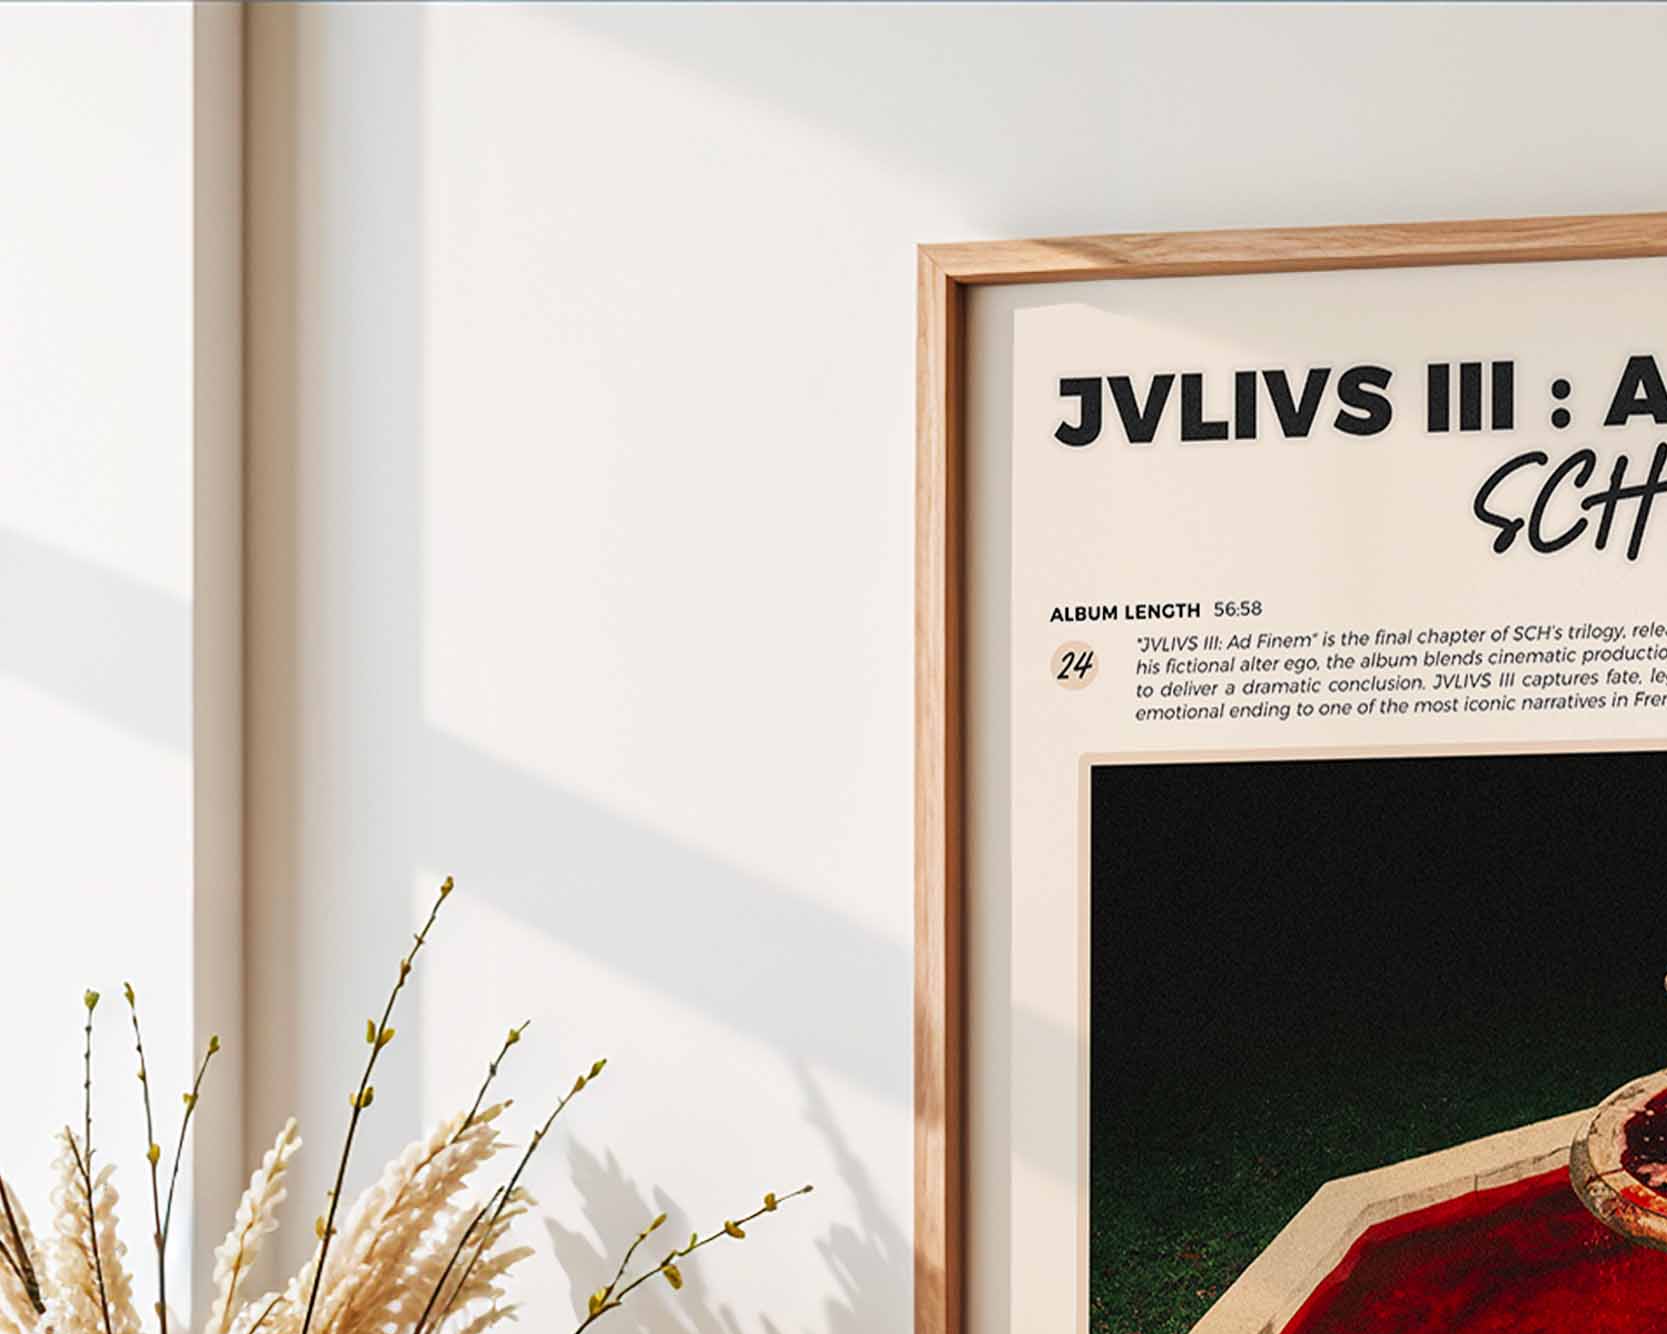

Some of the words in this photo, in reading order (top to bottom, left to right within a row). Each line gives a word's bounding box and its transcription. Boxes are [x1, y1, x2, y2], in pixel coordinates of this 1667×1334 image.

[1054, 365, 1393, 446] JVLIVS
[1426, 360, 1514, 433] III
[1550, 377, 1572, 429] :
[1049, 604, 1118, 623] ALBUM
[1124, 602, 1201, 621] LENGTH
[1213, 599, 1263, 618] 56:58
[1203, 635, 1223, 651] III:
[1225, 633, 1253, 651] Ad
[1321, 631, 1336, 648] is
[1340, 630, 1371, 647] the
[1374, 628, 1413, 646] final
[1416, 627, 1487, 647] chapter
[1490, 624, 1511, 643] of
[1056, 650, 1095, 680] 24
[1135, 658, 1161, 676] his
[1165, 656, 1236, 675] fictional
[1239, 655, 1280, 673] alter
[1326, 652, 1356, 671] the
[1359, 651, 1418, 669] album
[1423, 649, 1483, 668] blends
[1487, 646, 1577, 666] cinematic
[1136, 684, 1155, 699] to
[1160, 680, 1219, 698] deliver
[1224, 682, 1236, 697] a
[1241, 676, 1322, 696] dramatic
[1327, 674, 1426, 693] conclusion.
[1432, 671, 1492, 691] JVLIVS
[1498, 671, 1516, 688] III
[1521, 671, 1599, 691] captures
[1135, 702, 1226, 722] emotional
[1228, 700, 1292, 722] ending
[1296, 702, 1315, 717] to
[1317, 702, 1353, 717] one
[1356, 697, 1377, 716] of
[1379, 697, 1410, 715] the
[1413, 697, 1459, 713] most
[1463, 694, 1517, 713] iconic
[1521, 692, 1607, 711] narratives
[1611, 691, 1629, 708] in
